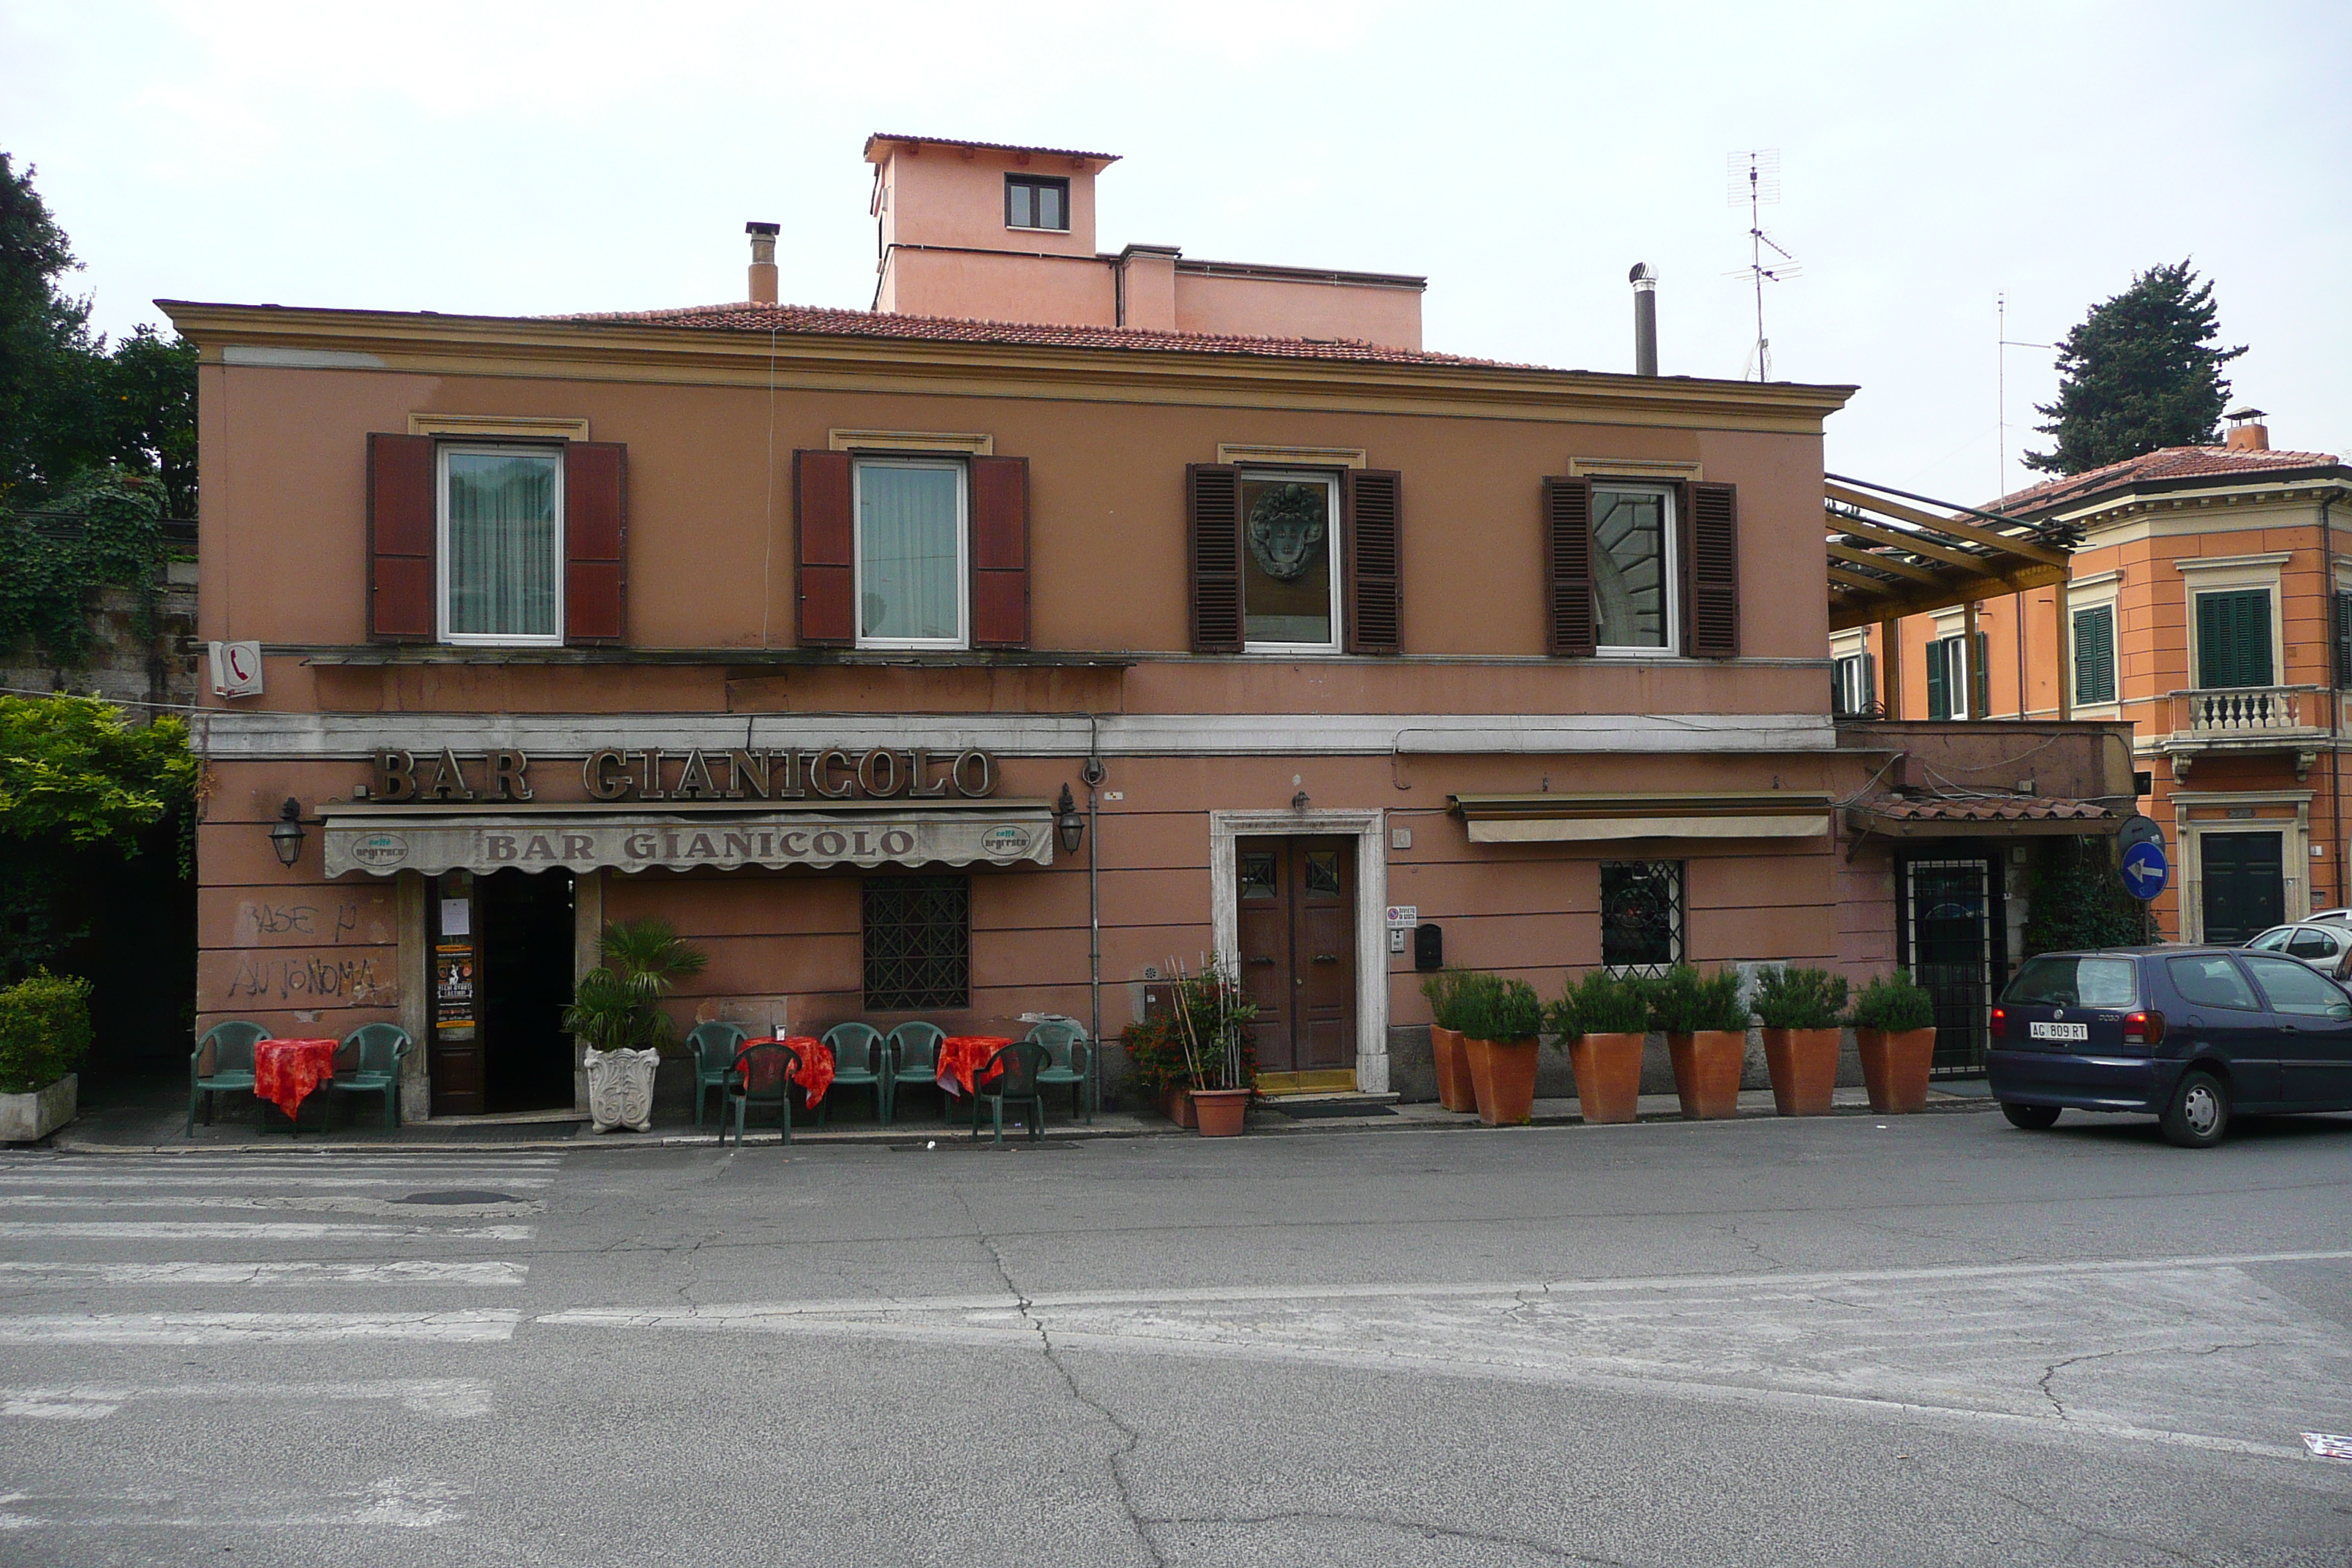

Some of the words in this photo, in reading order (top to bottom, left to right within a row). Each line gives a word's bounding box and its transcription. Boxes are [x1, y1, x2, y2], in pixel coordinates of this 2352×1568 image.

[370, 747, 533, 801] BAR
[584, 747, 1000, 800] GIANICOLO
[486, 834, 595, 861] BAR
[624, 830, 914, 859] GIANICOLO
[2033, 1025, 2045, 1036] AG
[2051, 1025, 2069, 1037] 809
[2073, 1026, 2085, 1038] RT
